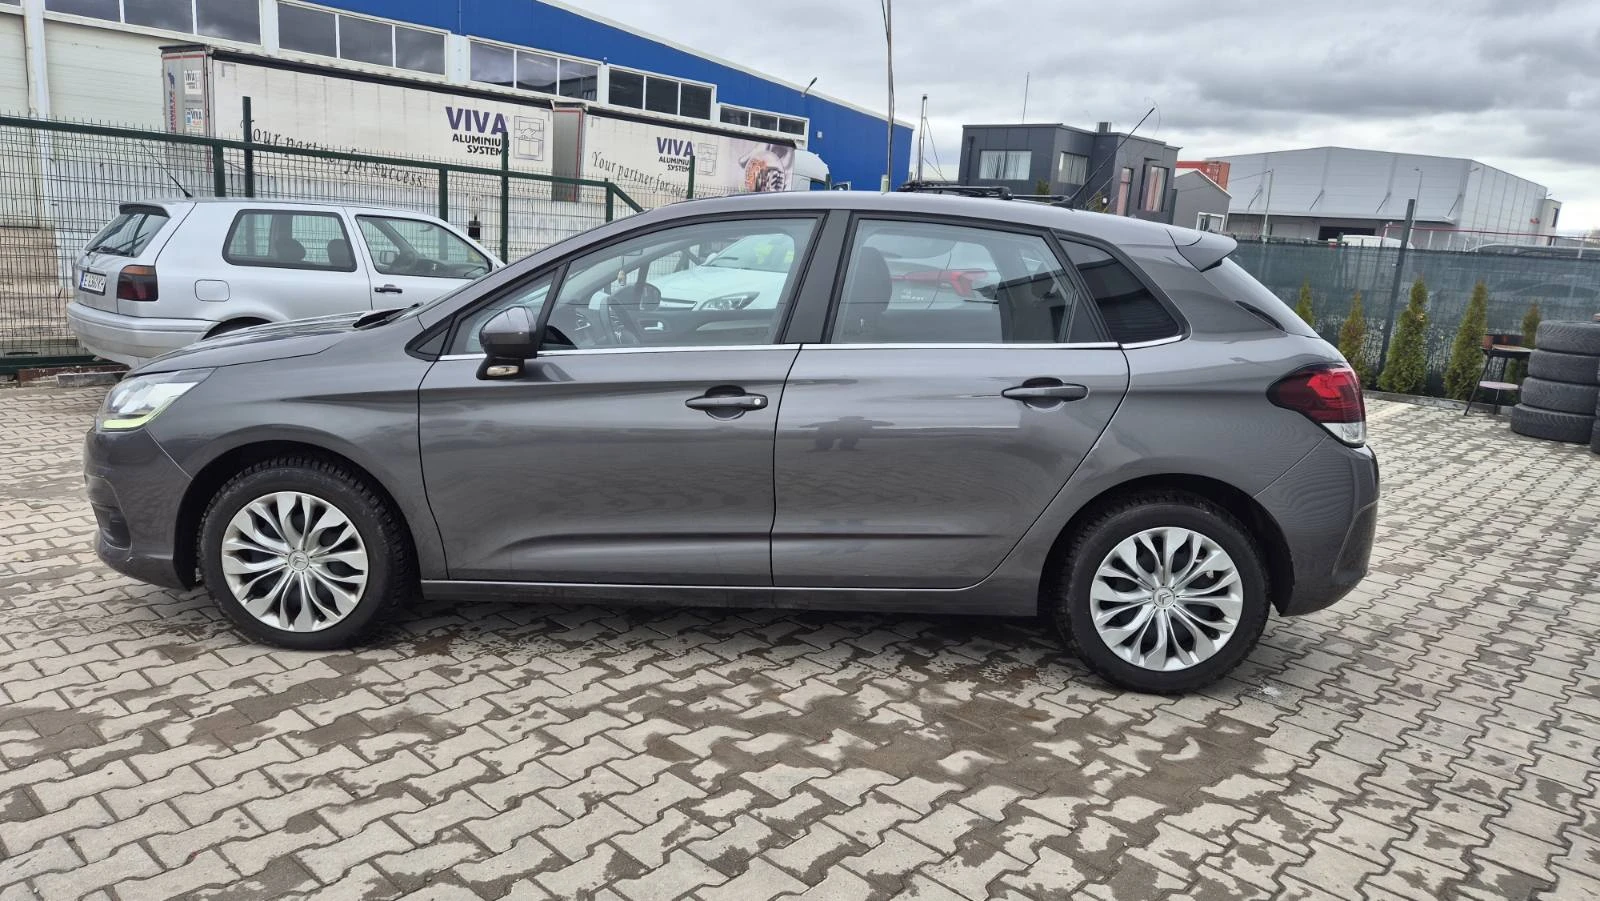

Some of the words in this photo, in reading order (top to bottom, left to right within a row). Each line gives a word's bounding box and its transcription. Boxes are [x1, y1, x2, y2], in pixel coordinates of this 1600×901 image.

[444, 106, 508, 134] VIVA
[452, 134, 502, 147] ALUMINIU
[656, 136, 694, 157] VIVA
[659, 156, 690, 166] ALUMINIU
[592, 151, 617, 173] Your
[617, 165, 653, 185] partner
[653, 173, 670, 194] for
